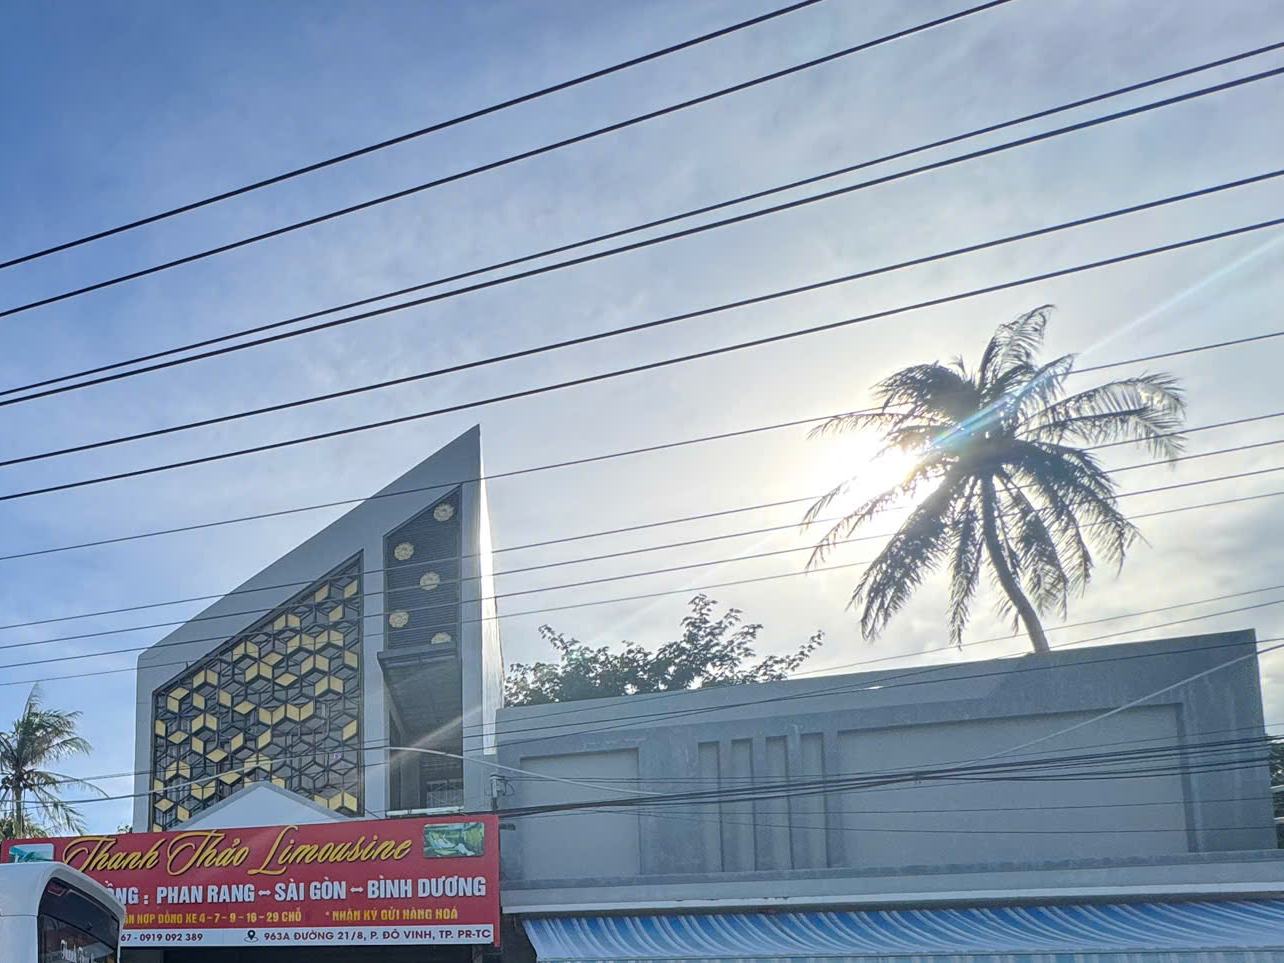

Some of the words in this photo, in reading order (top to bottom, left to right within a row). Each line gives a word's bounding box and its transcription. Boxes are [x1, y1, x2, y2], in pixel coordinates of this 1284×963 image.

[62, 835, 166, 873] Thanh
[167, 829, 249, 876] Thảo
[247, 825, 412, 875] Limousine
[156, 885, 203, 904] PHAN
[207, 883, 255, 903] RANG
[274, 878, 305, 901] SÀI
[309, 876, 347, 900] GÒN
[367, 874, 413, 899] BÌNH
[418, 875, 486, 898] DƯƠNG
[185, 912, 197, 924] XE
[139, 933, 163, 942] 0919
[165, 933, 183, 941] 092
[185, 933, 203, 941] 389
[264, 932, 290, 941] 963A
[293, 930, 334, 940] ĐƯỜNG
[337, 931, 367, 941] 21/8,
[370, 931, 379, 939] P.
[403, 930, 436, 940] VINH,
[439, 930, 454, 939] TP.
[457, 929, 491, 939] PR-TC
